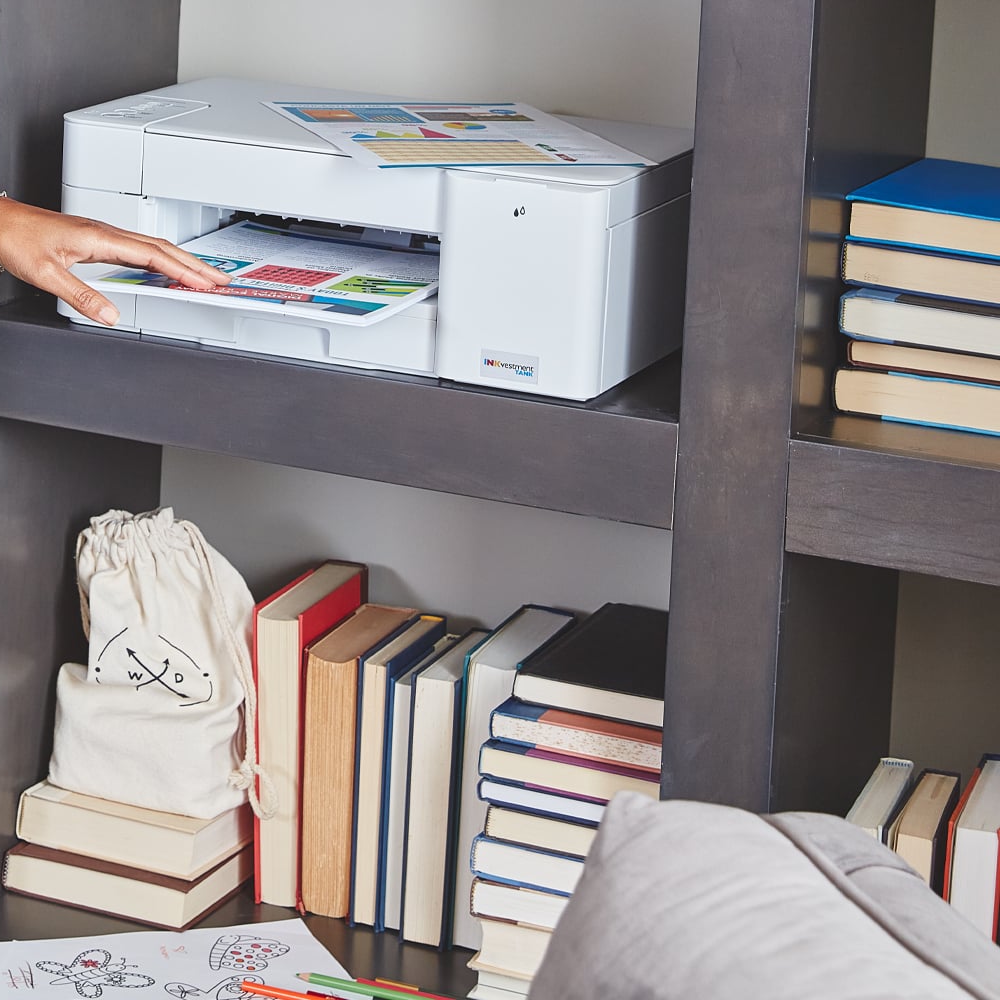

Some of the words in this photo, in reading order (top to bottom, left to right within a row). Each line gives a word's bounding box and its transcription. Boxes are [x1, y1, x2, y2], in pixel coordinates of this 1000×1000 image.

[484, 358, 534, 372] INKvestment
[128, 671, 143, 681] W
[175, 673, 184, 683] D
